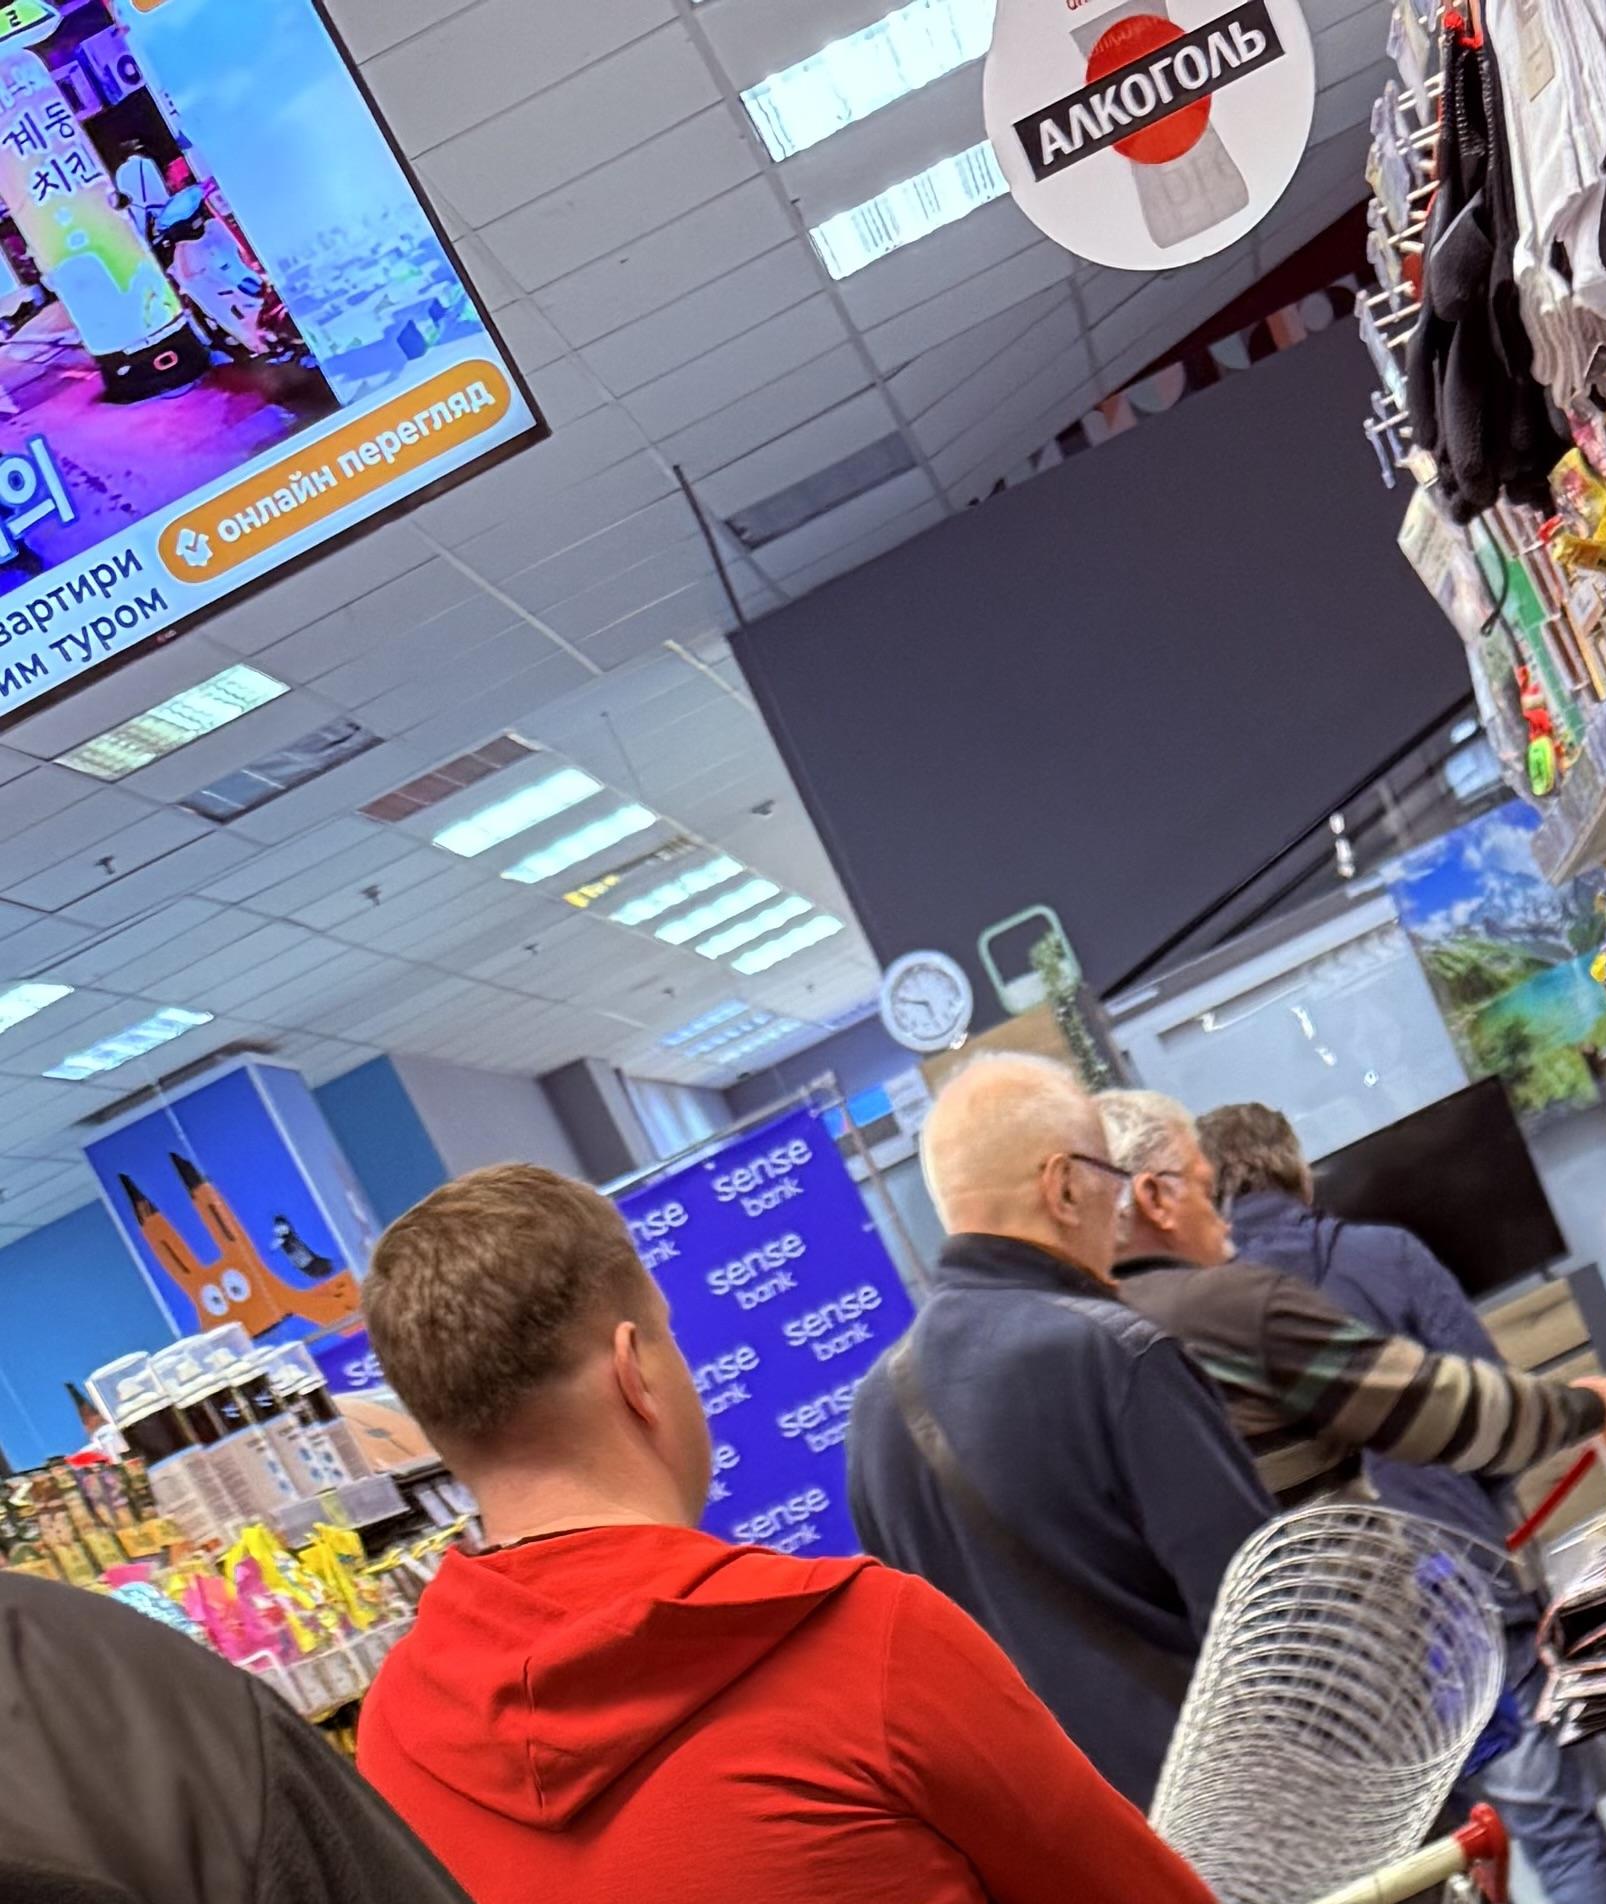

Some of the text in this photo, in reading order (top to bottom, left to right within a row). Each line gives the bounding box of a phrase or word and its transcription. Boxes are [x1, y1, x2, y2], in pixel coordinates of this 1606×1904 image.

[1041, 20, 1267, 166] АЛКОГОЛЬ
[216, 381, 496, 543] онлайн перегляд
[0, 547, 144, 647] вартири
[0, 587, 169, 696] им туром
[711, 1138, 812, 1204] sense
[740, 1178, 804, 1218] bank
[626, 1199, 688, 1243] nse
[706, 1231, 807, 1297] sense
[736, 1270, 799, 1311] bank
[782, 1282, 883, 1347] sense
[811, 1321, 873, 1362] bank
[776, 1375, 869, 1439] sens
[733, 1487, 830, 1547] sense
